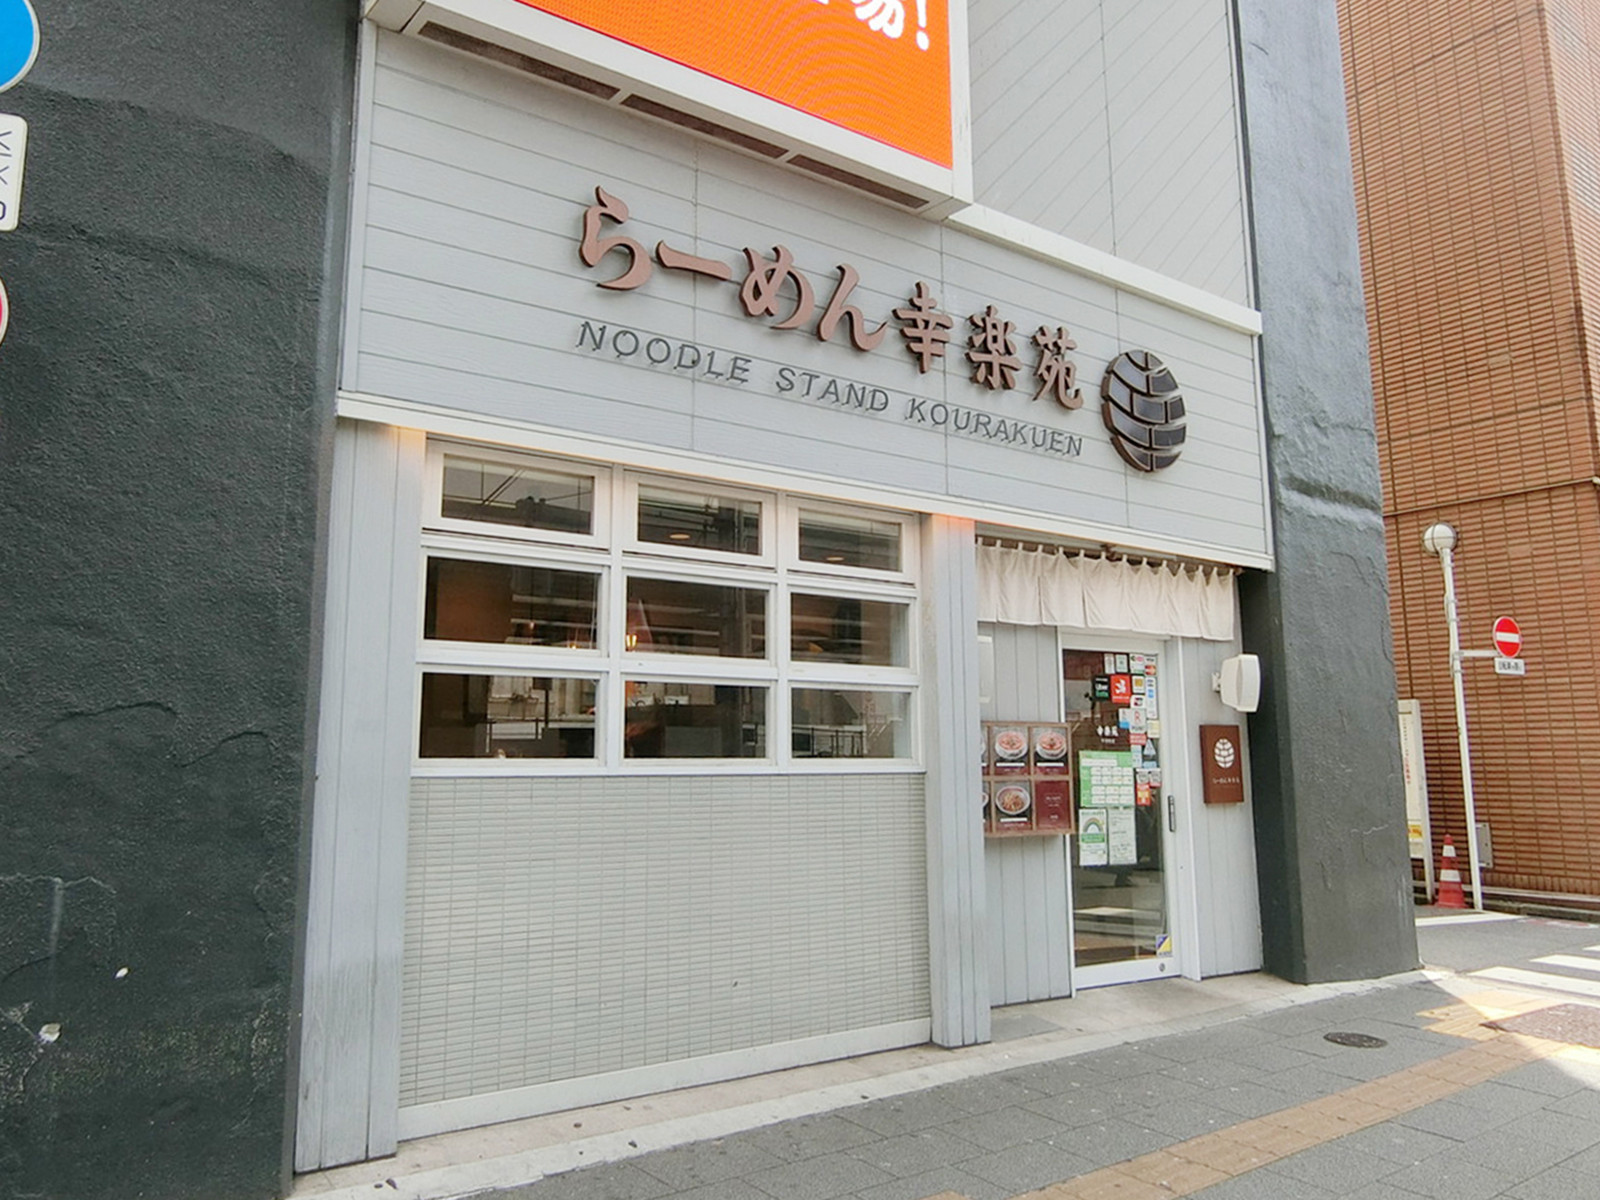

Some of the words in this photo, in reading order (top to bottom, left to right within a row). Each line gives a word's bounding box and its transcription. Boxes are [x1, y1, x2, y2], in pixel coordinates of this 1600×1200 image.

[579, 186, 1083, 410] らーめん幸楽苑
[577, 321, 752, 383] NOODLE
[776, 367, 888, 411] STAND
[907, 398, 1082, 456] KOURAKUEN
